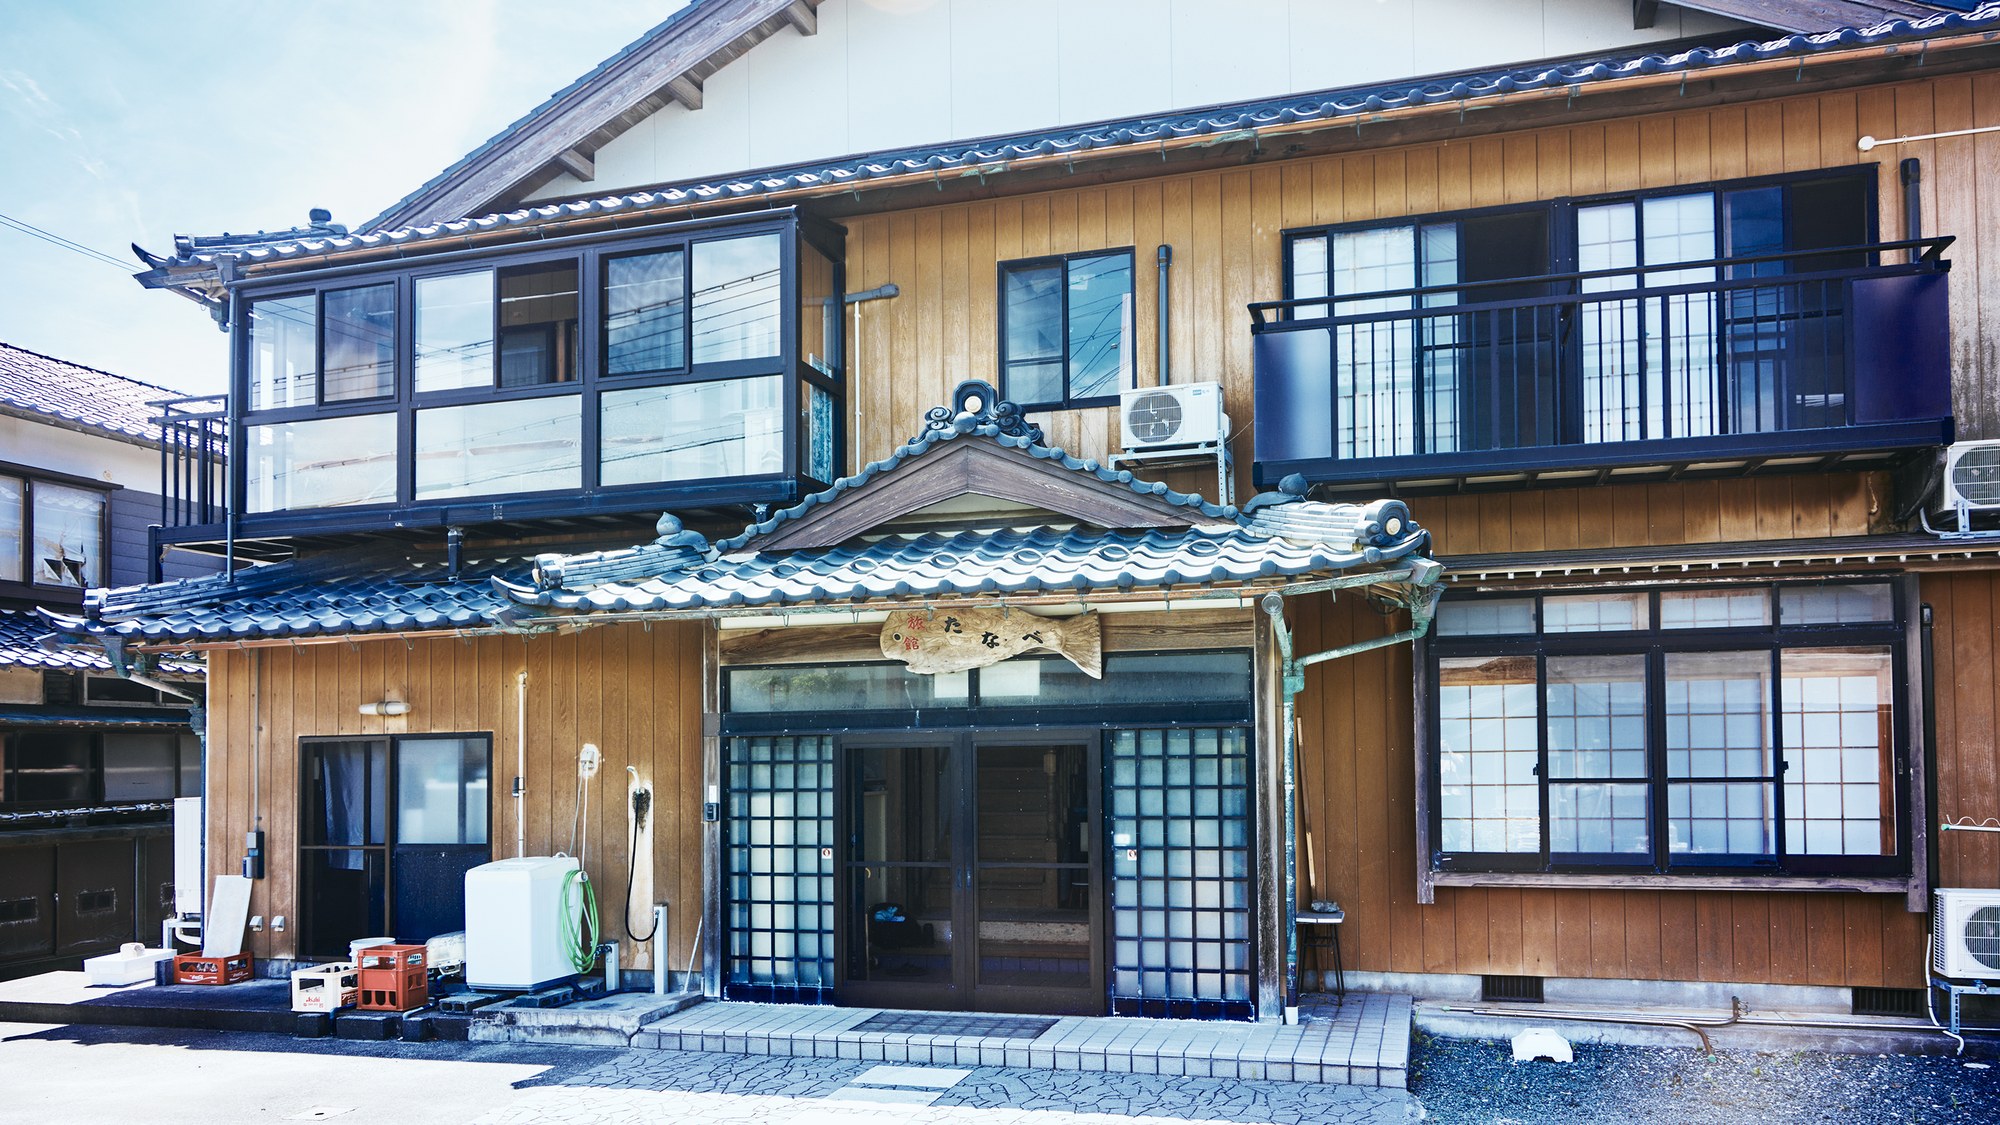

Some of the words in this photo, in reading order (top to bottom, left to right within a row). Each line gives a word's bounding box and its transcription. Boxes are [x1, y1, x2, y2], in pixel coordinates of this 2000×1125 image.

[903, 613, 926, 650] 旅館
[944, 616, 1043, 649] たなべ
